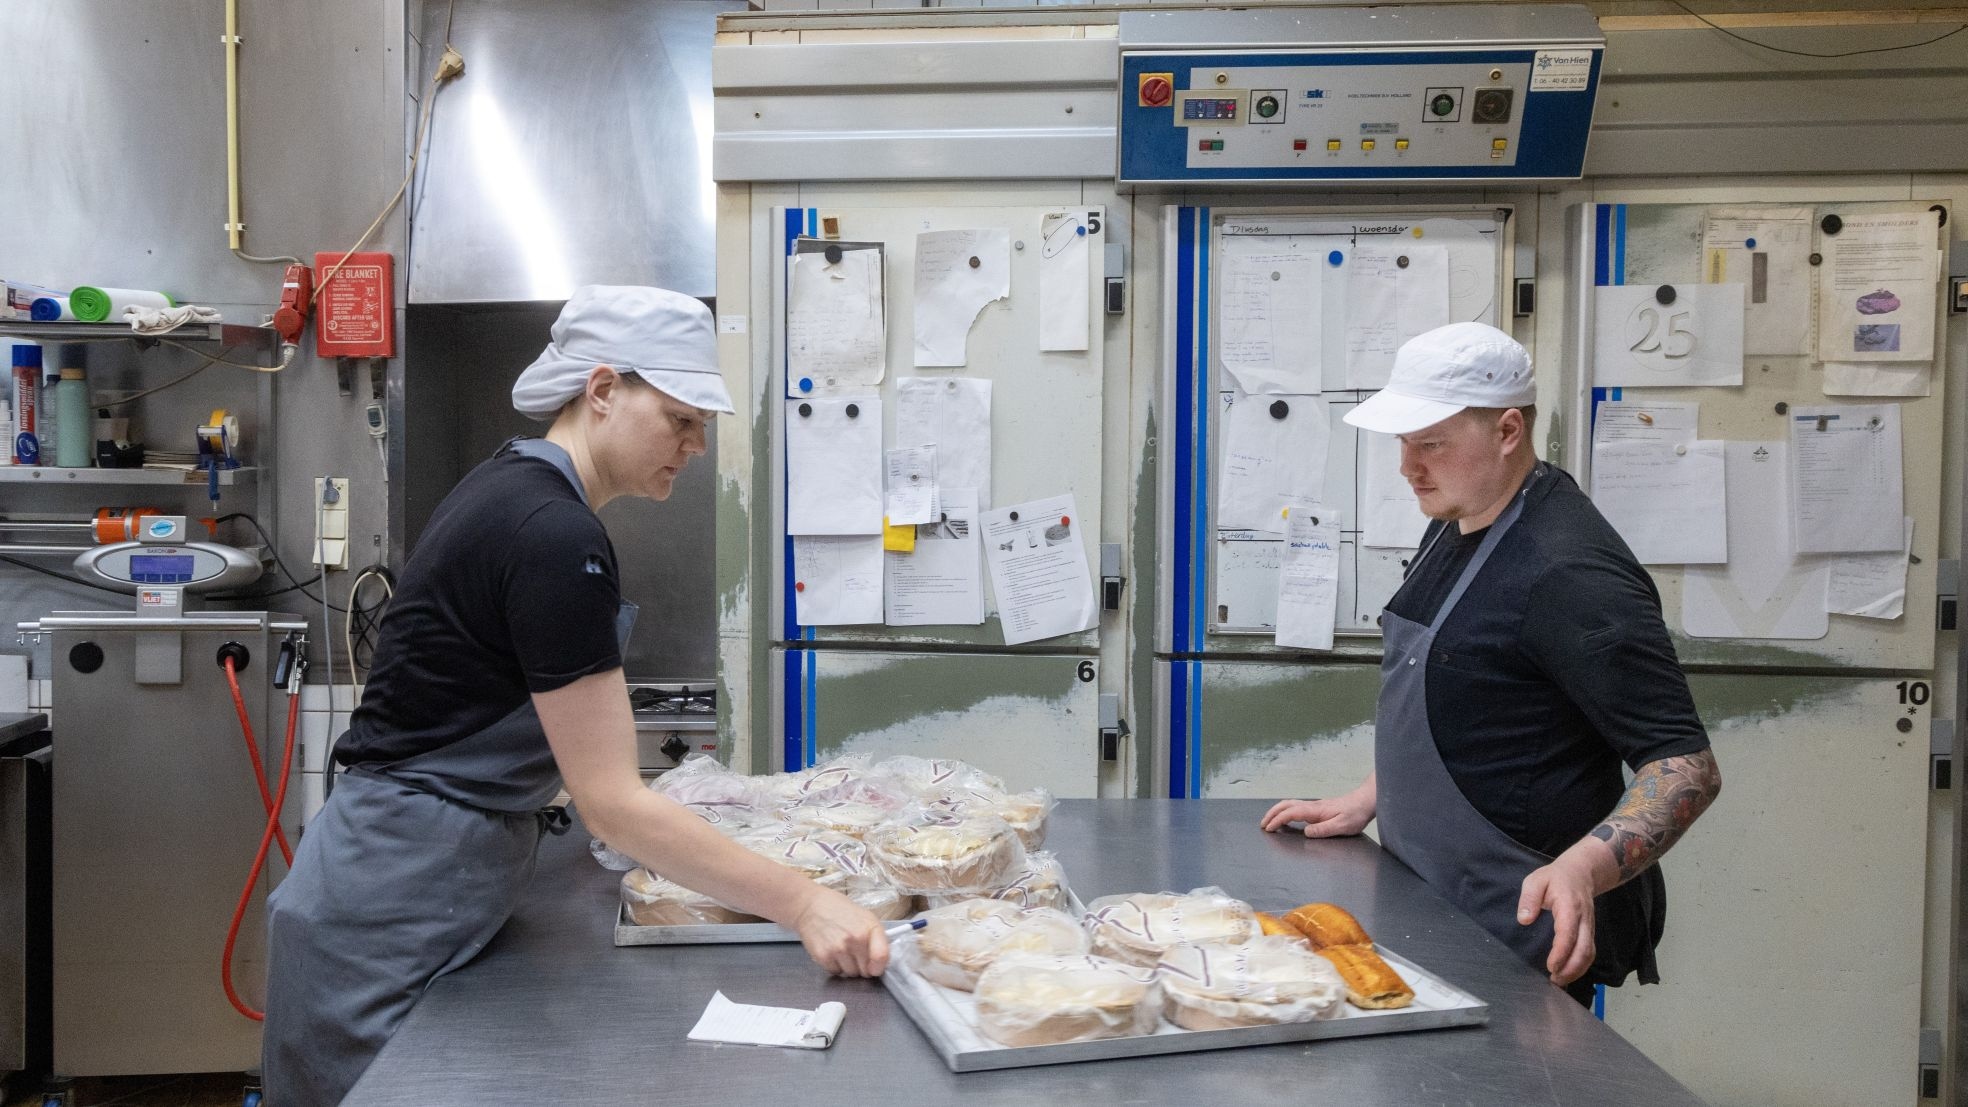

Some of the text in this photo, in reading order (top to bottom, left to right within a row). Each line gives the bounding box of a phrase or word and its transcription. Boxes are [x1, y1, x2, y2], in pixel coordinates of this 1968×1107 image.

[1087, 212, 1101, 235] 5
[346, 269, 378, 278] BLANKET
[1629, 308, 1697, 359] 25
[1077, 660, 1095, 683] 6
[1896, 681, 1930, 705] 10
